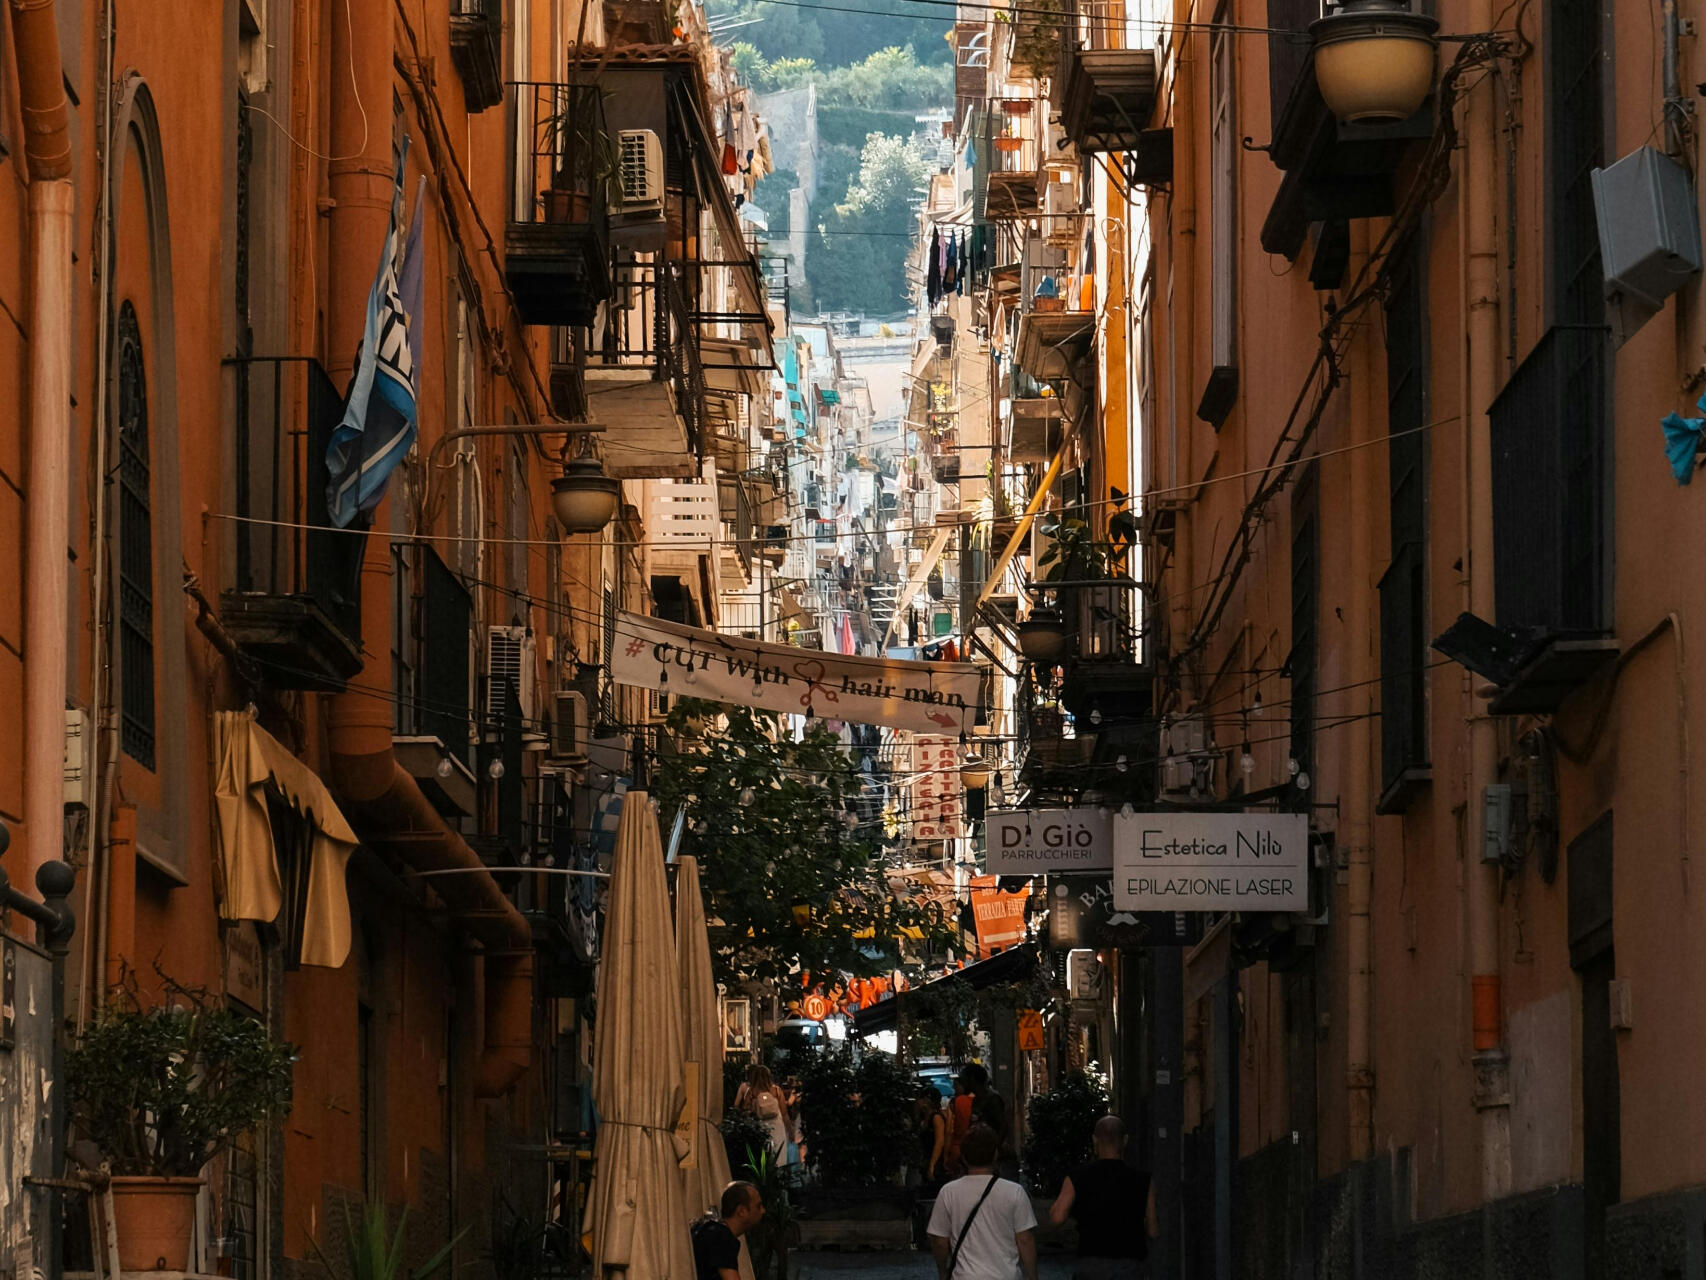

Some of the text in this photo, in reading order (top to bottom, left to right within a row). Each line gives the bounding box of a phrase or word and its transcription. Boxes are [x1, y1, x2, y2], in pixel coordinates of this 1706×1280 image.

[653, 642, 717, 672] CUT
[840, 675, 896, 699] hair
[904, 687, 964, 707] man
[1043, 823, 1093, 848] Giò
[1140, 830, 1282, 859] Estetica Nilù
[1001, 849, 1093, 860] PARRUCCHIERI
[1127, 878, 1294, 896] EPILAZIONE LASER
